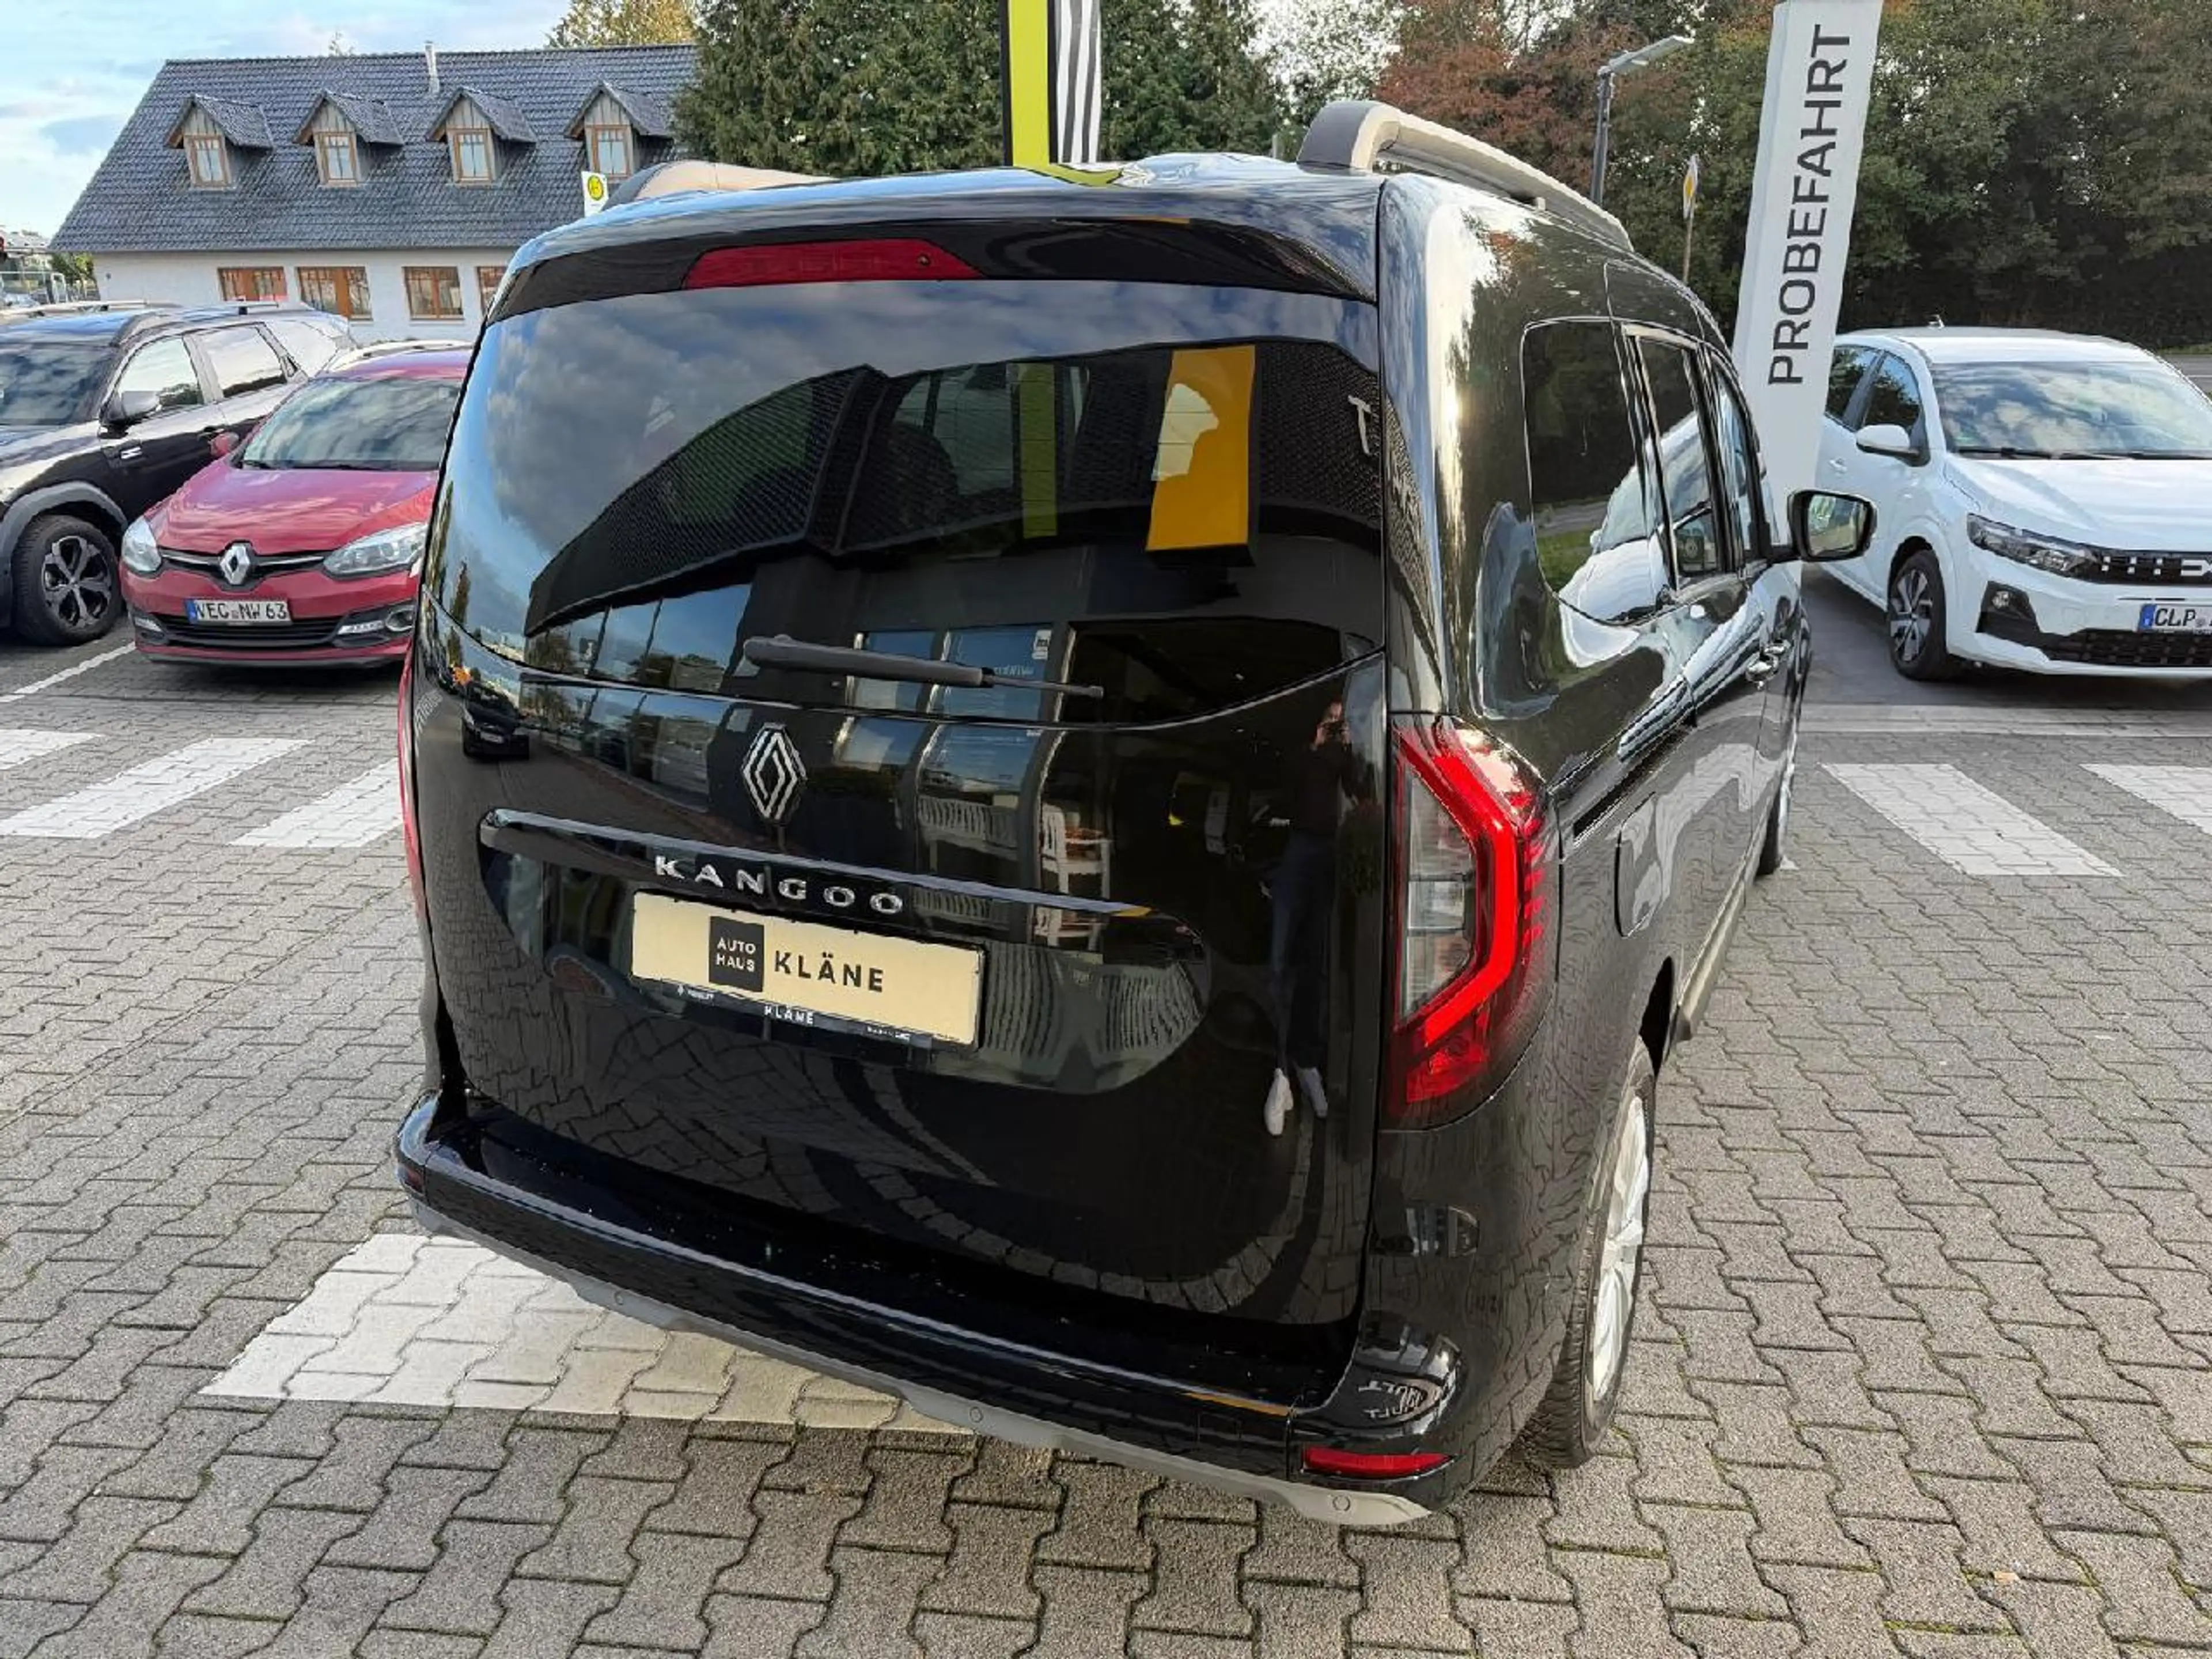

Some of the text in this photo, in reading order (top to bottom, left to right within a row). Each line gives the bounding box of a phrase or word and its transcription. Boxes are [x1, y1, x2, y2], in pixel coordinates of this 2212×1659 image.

[1768, 24, 1850, 385] PROBEFAHRT
[196, 603, 229, 618] VEC
[266, 603, 287, 619] 63
[2155, 608, 2196, 627] CLP
[654, 855, 903, 915] KANGOO
[716, 937, 756, 955] AUTO
[715, 953, 756, 972] HAUS
[774, 950, 884, 992] KLÄNE
